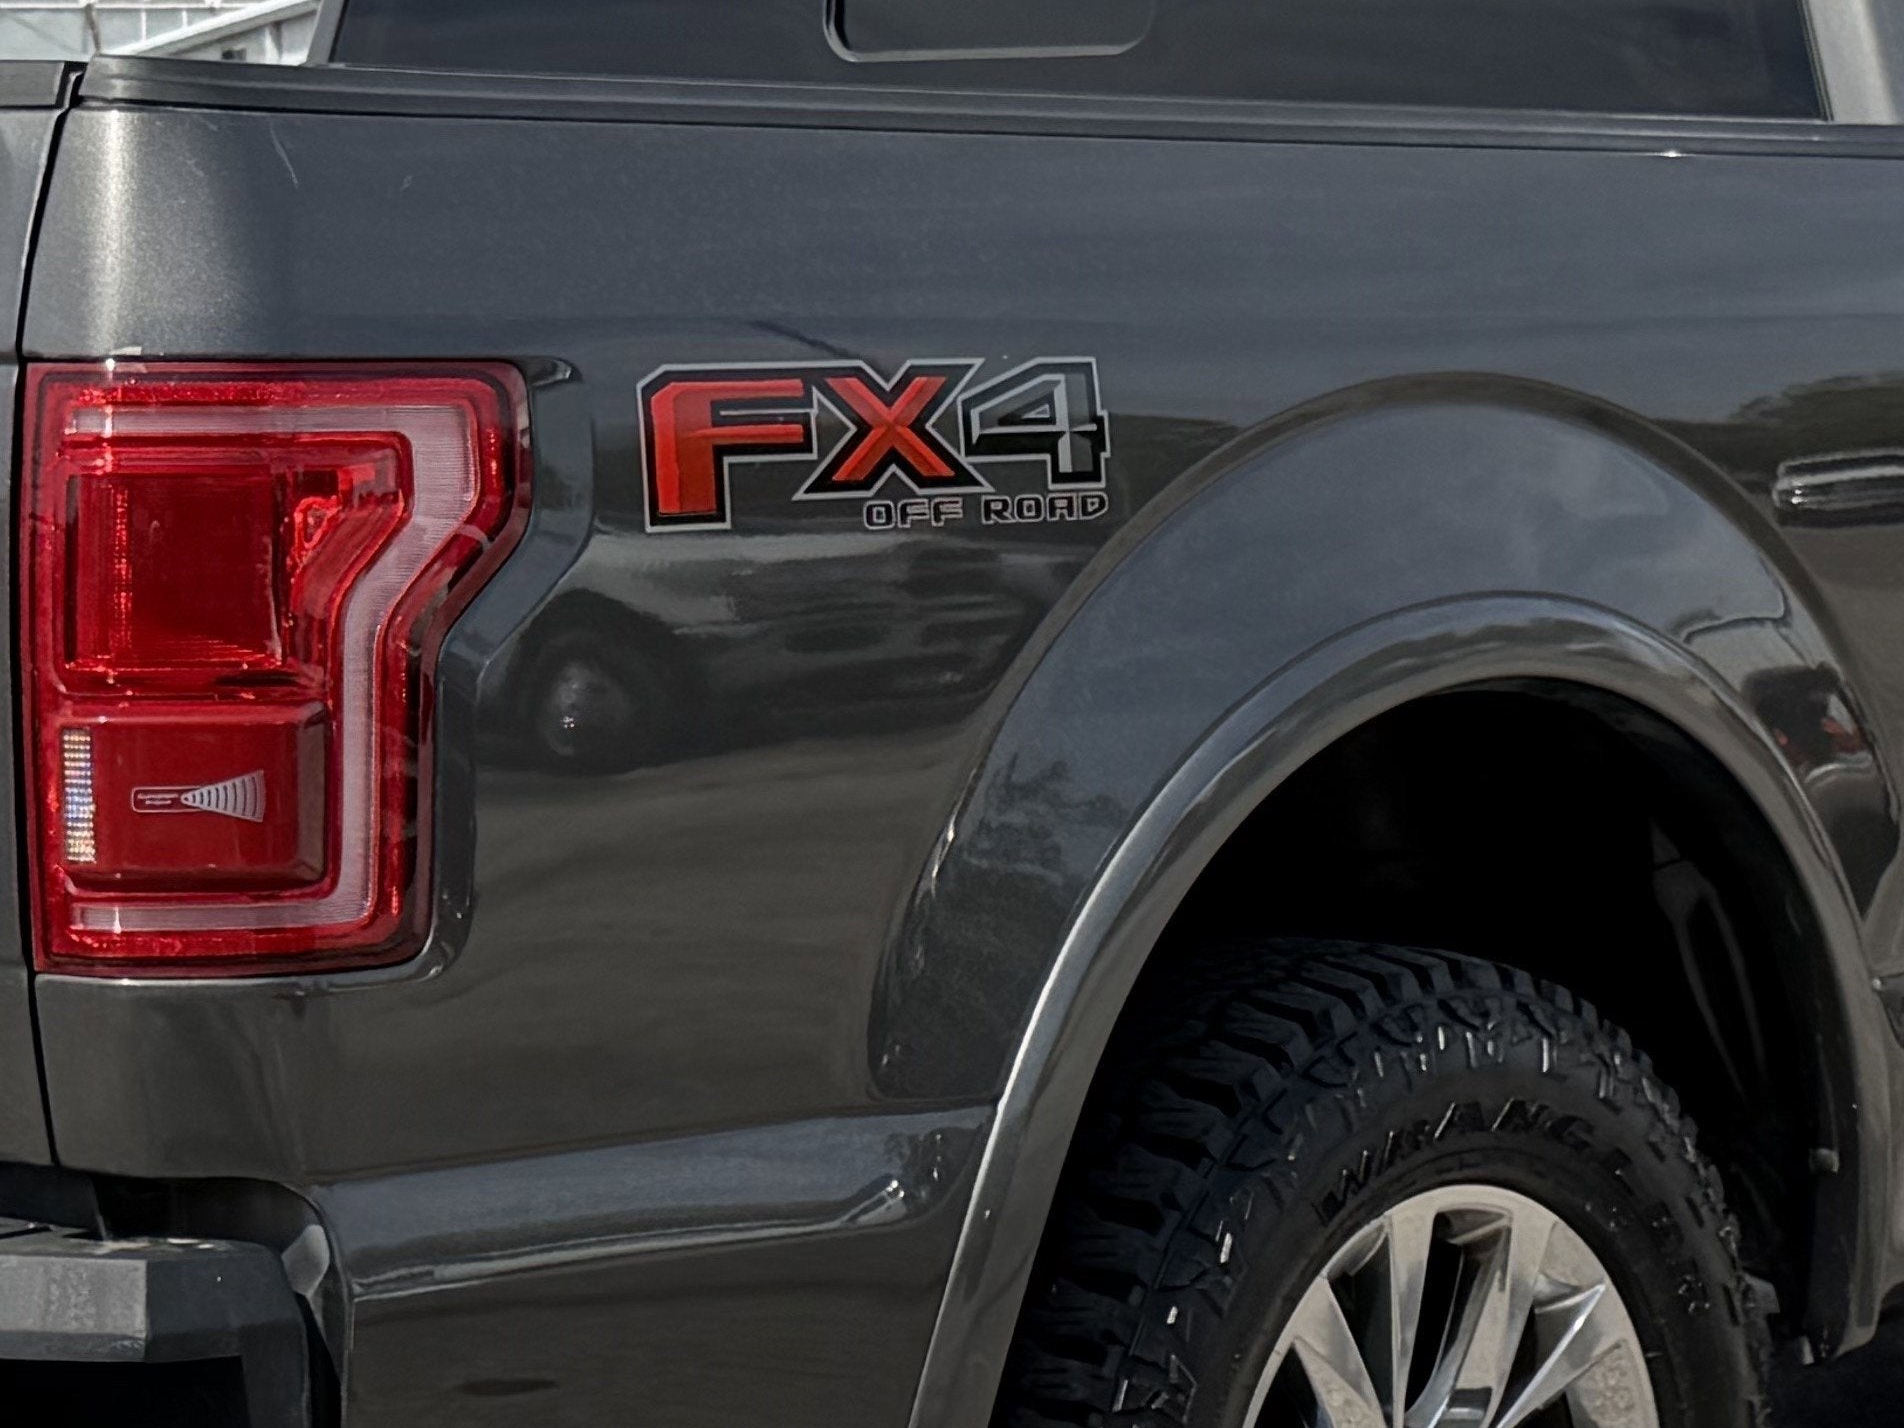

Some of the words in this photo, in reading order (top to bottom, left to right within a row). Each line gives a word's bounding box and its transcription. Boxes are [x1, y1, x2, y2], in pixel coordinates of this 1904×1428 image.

[637, 356, 1110, 534] FX4
[863, 496, 964, 529] OFF
[982, 491, 1109, 524] ROAD
